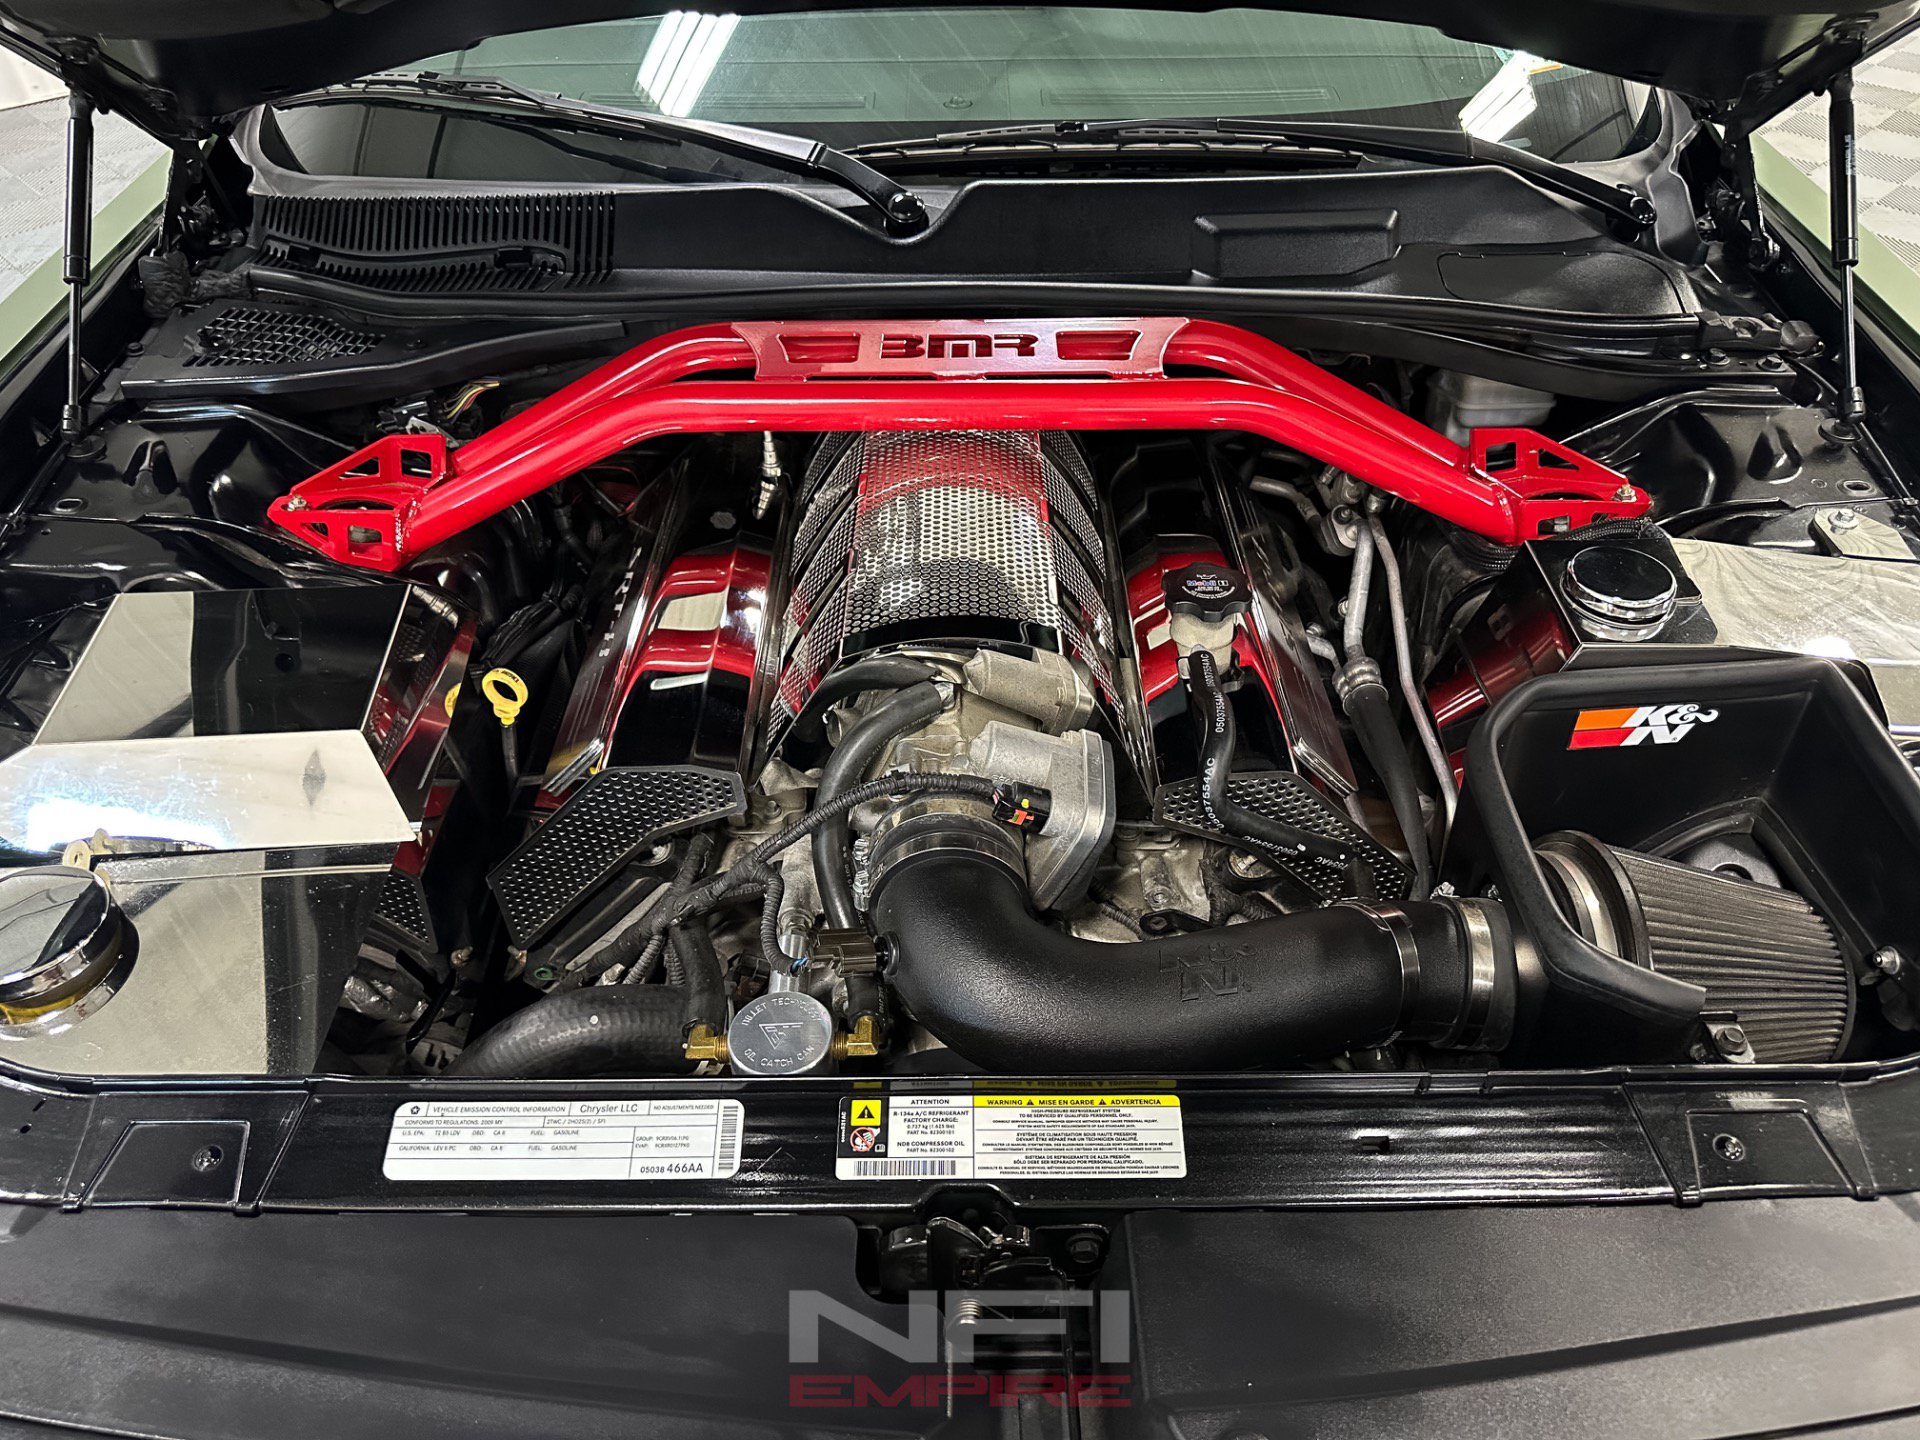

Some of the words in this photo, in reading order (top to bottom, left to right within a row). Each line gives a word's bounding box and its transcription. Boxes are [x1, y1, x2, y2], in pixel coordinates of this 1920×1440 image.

[880, 333, 1039, 358] BMR
[760, 1056, 794, 1068] CATCH
[580, 1104, 618, 1114] Chrysler
[620, 1104, 638, 1112] LLC
[640, 1166, 664, 1174] 05038
[667, 1163, 704, 1174] 466AA
